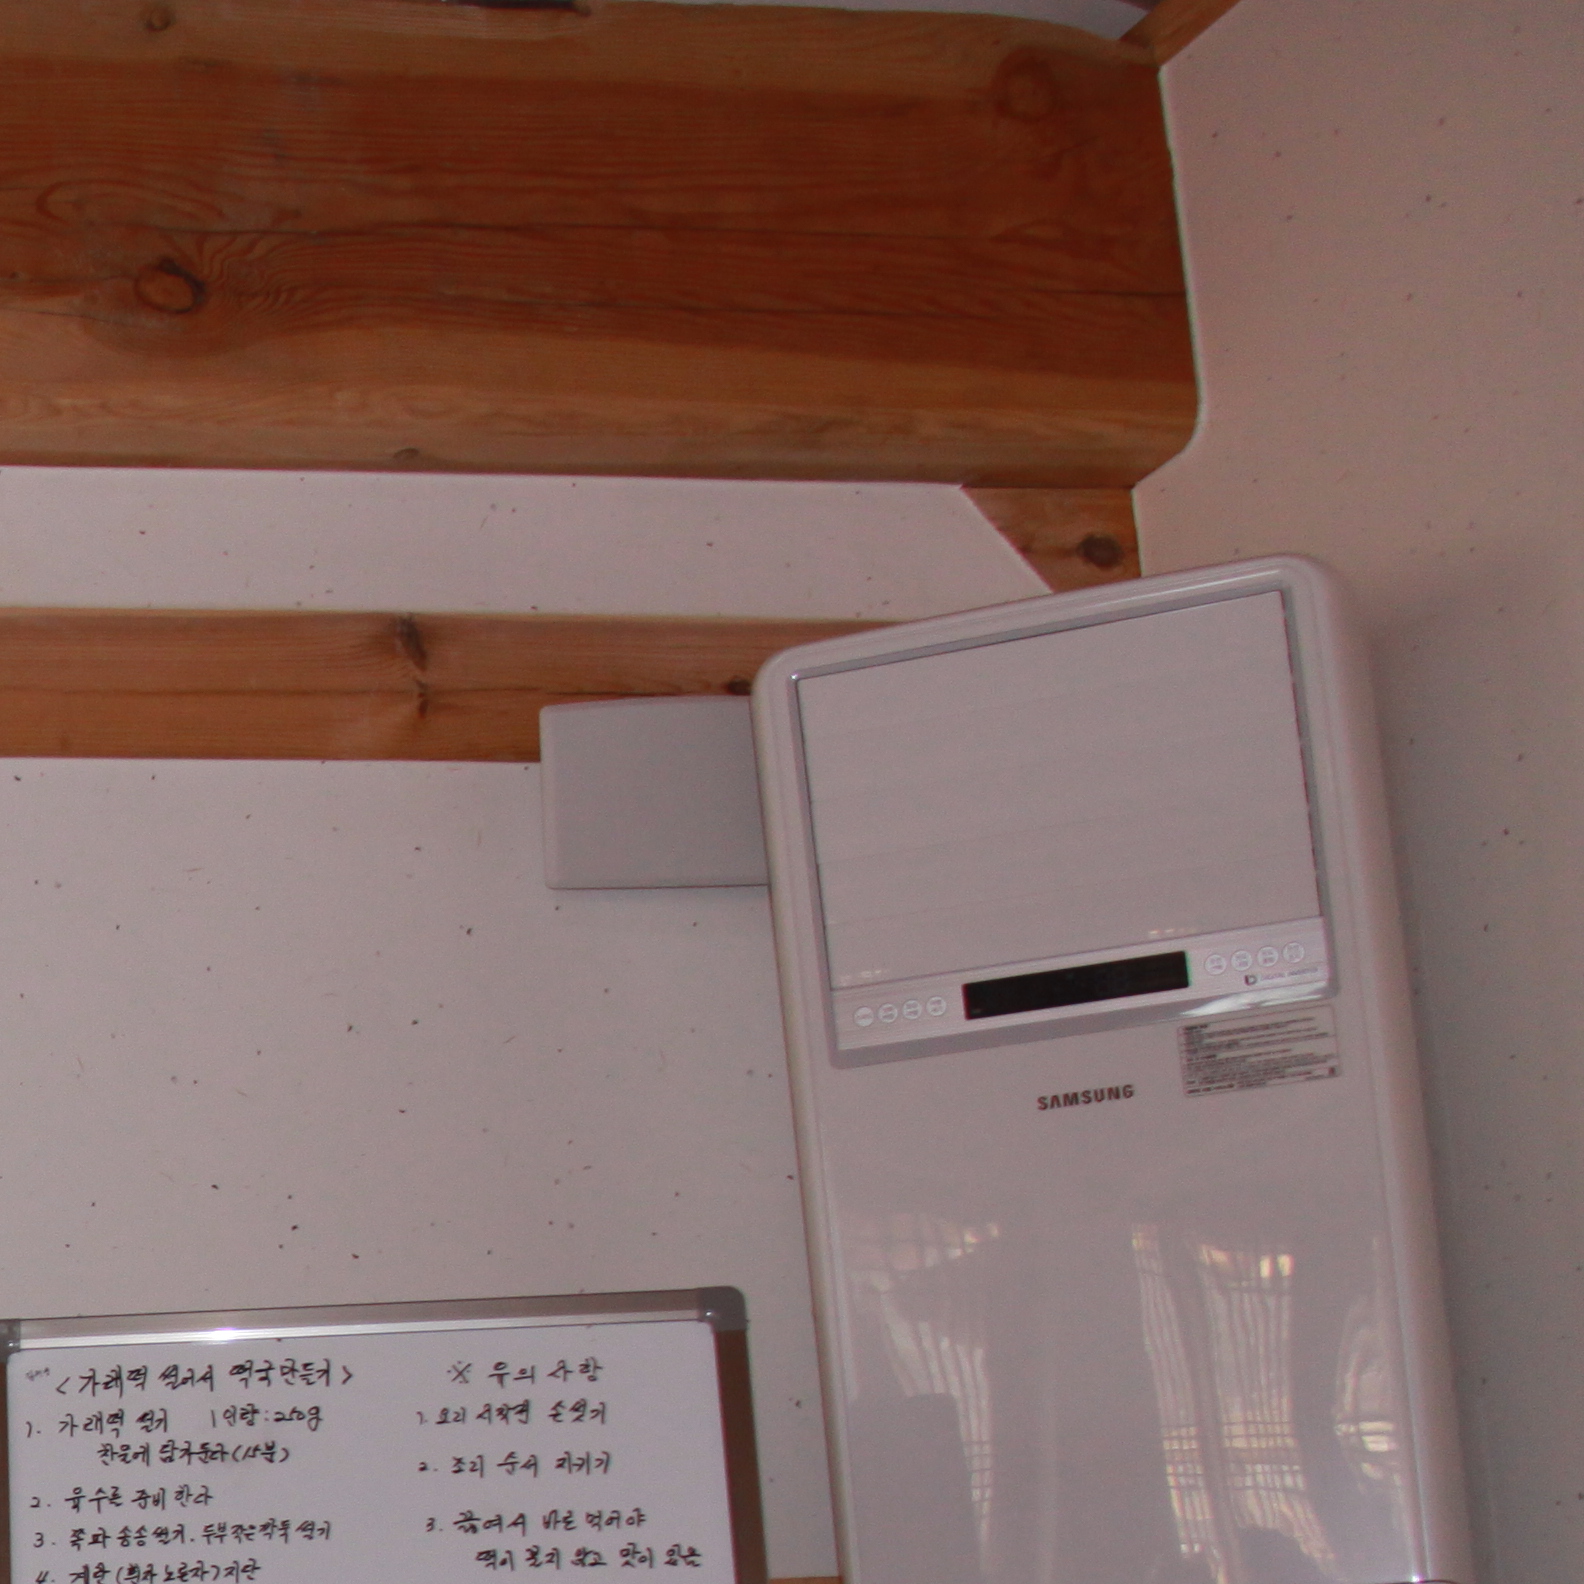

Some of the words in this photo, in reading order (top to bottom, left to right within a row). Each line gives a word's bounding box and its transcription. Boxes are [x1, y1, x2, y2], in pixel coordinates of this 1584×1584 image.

[1036, 1084, 1135, 1110] SAMSUNG
[546, 1355, 605, 1383] 사항
[58, 1407, 126, 1439] 가래떡
[134, 1406, 169, 1434] 썰기
[434, 1405, 468, 1426] 요리
[547, 1397, 608, 1426] 손씻기
[495, 1450, 540, 1479] 순서
[554, 1450, 613, 1476] 지키기
[63, 1485, 124, 1515] 육수를
[129, 1486, 167, 1512] 준비
[173, 1483, 215, 1509] 한다
[541, 1508, 578, 1532] 바로
[584, 1506, 648, 1533] 먹어야
[68, 1526, 113, 1553] 쪽파
[474, 1548, 516, 1573] 떡이
[618, 1541, 656, 1570] 맛이
[663, 1542, 703, 1569] 있음
